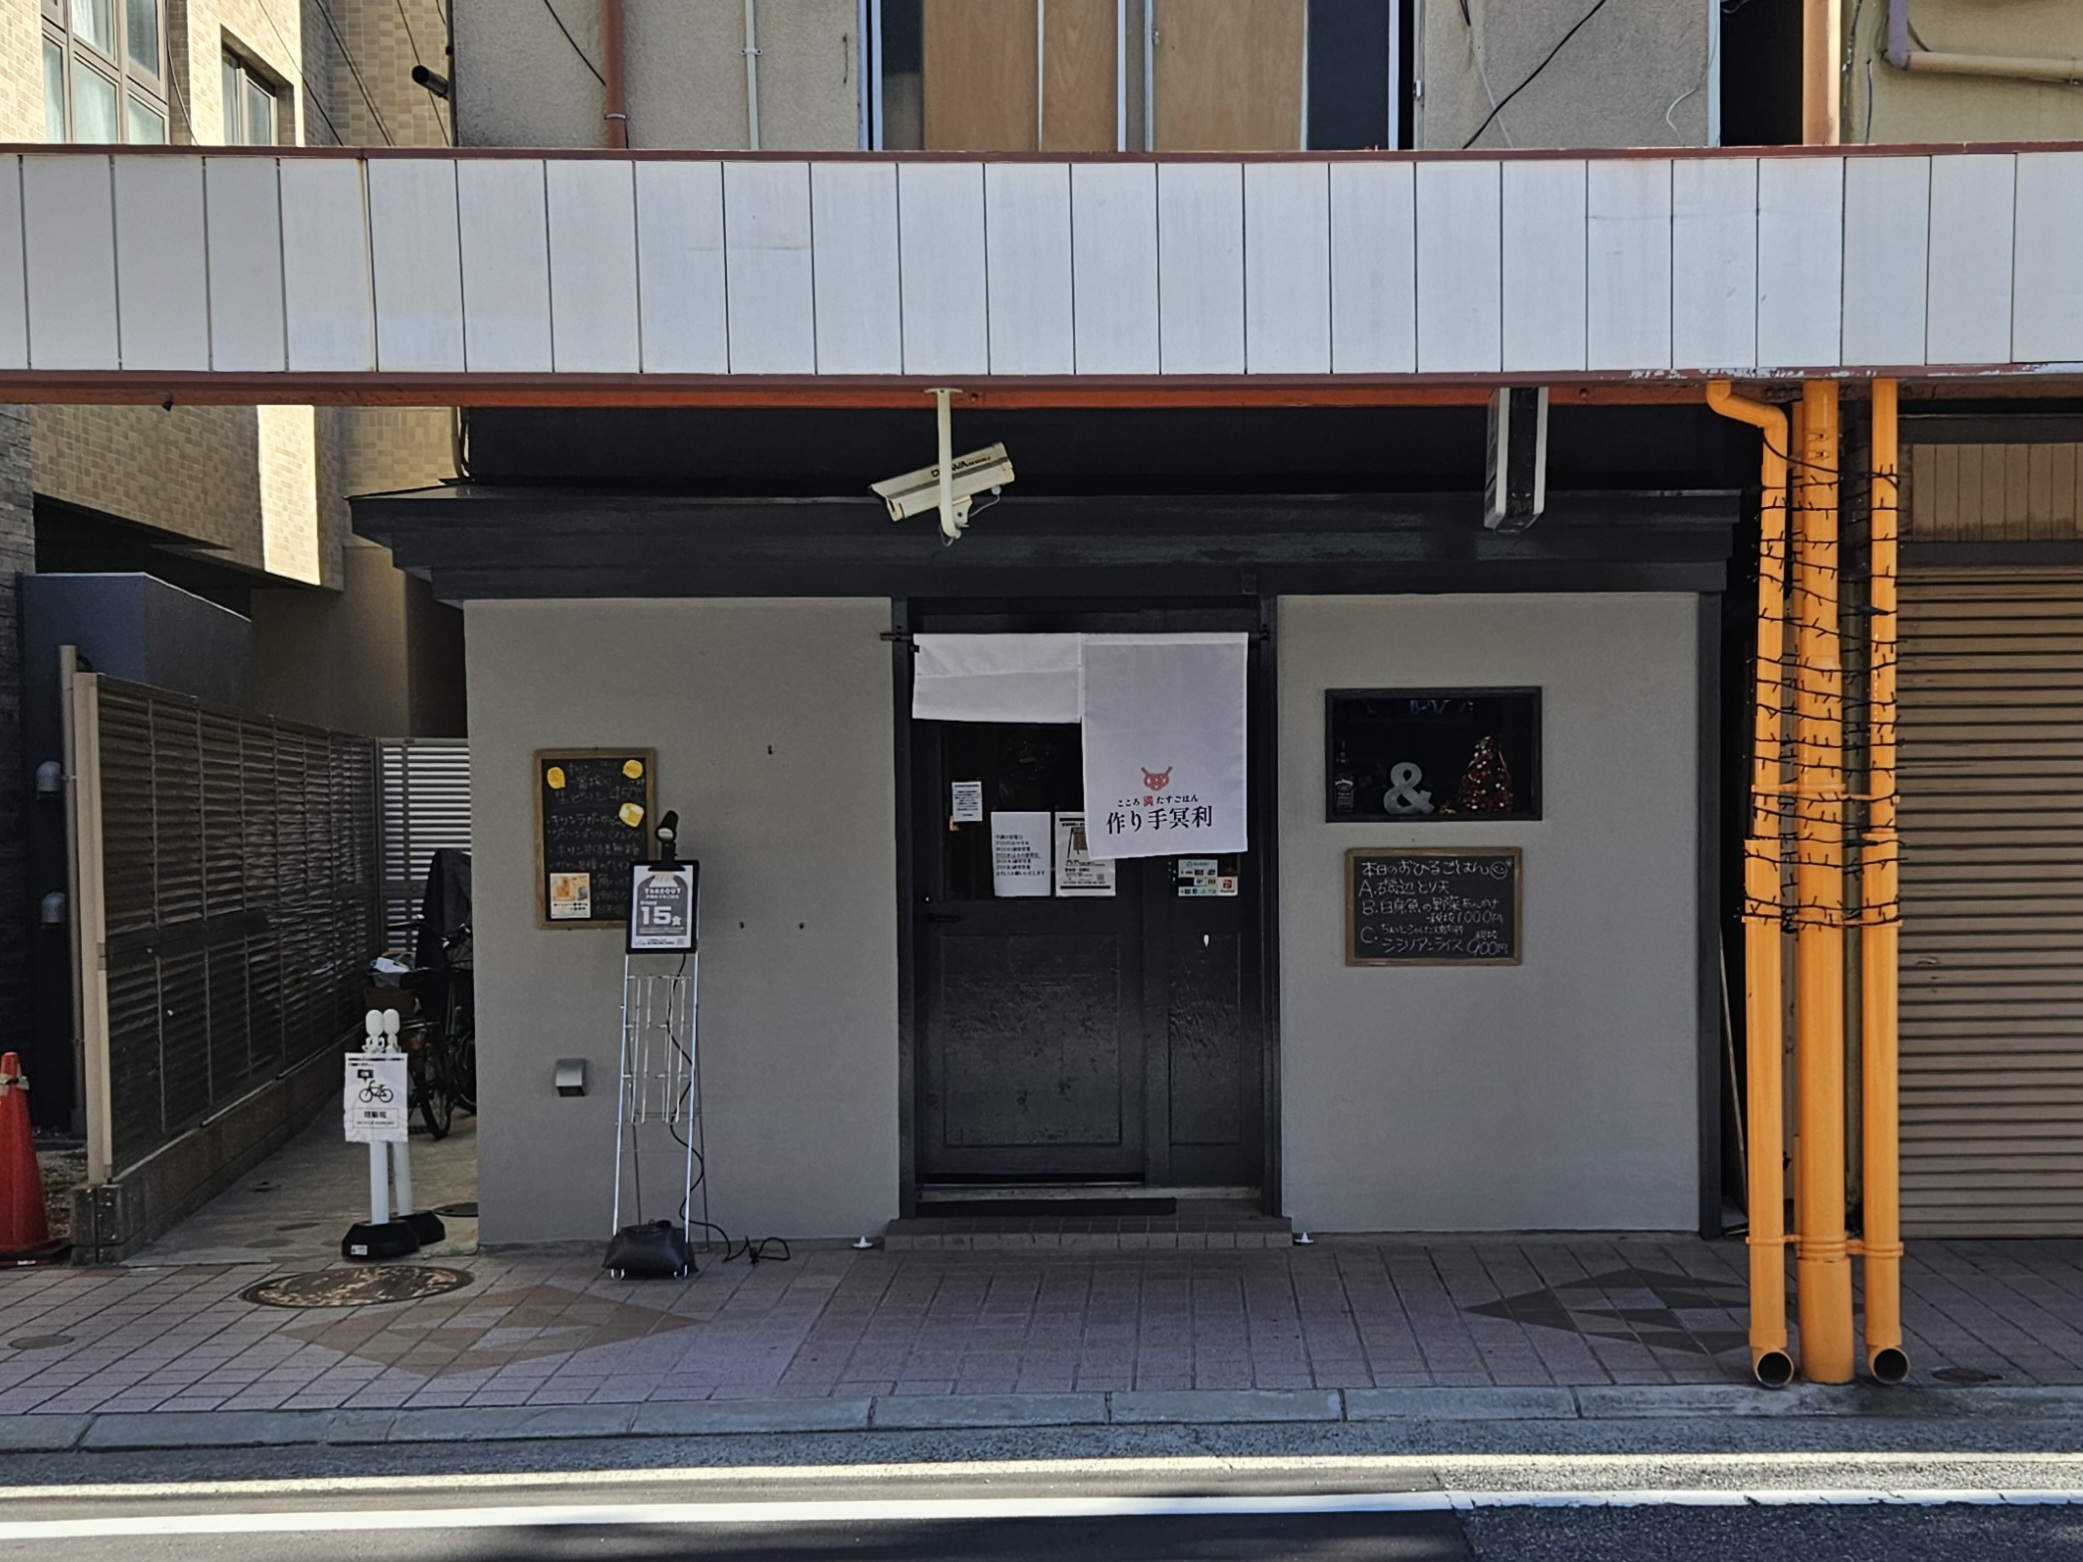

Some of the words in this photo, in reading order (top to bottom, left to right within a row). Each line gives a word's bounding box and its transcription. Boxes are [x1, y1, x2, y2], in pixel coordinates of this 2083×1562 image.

[1117, 794, 1199, 808] こころ満たすごはん
[1106, 805, 1213, 835] 作り手冥利
[645, 887, 681, 895] TAKEOUT
